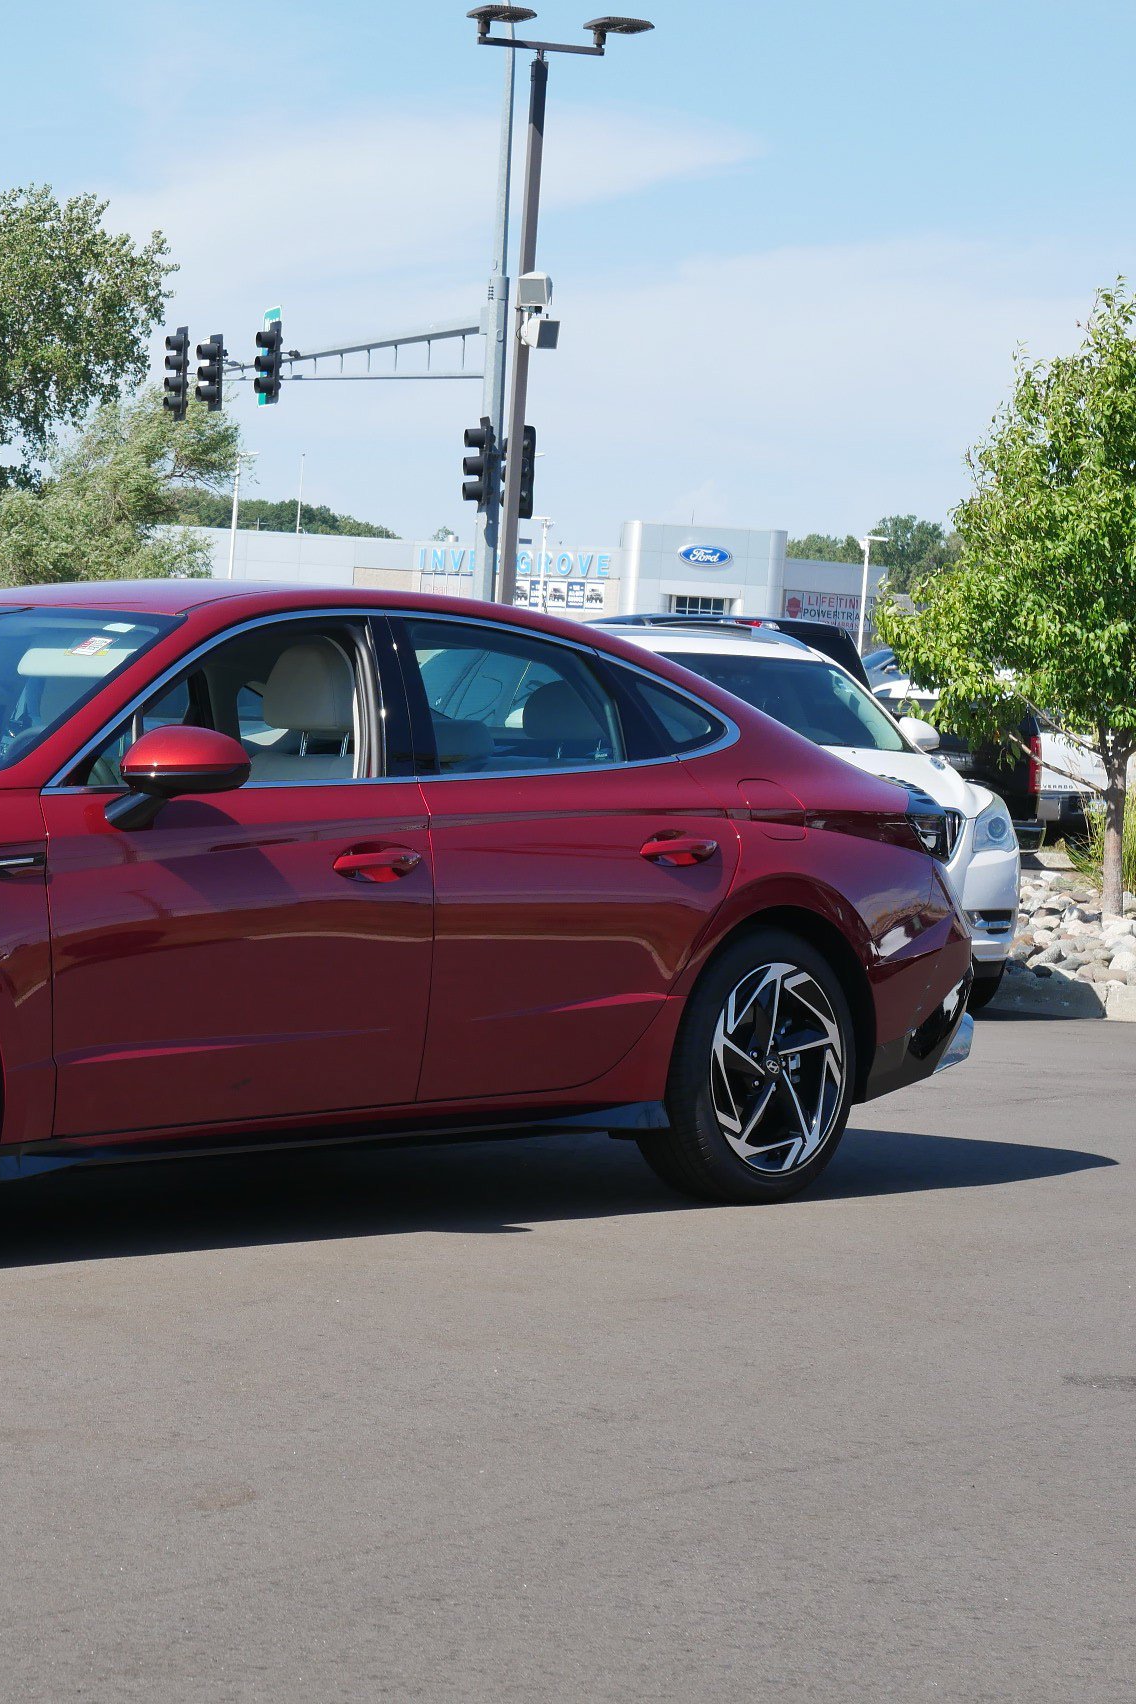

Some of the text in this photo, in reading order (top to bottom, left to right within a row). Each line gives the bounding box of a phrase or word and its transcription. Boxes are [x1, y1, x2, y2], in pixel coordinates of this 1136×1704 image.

[418, 548, 611, 577] INVE GROVE
[689, 548, 720, 563] Ford
[807, 595, 862, 609] LIFETIM
[802, 608, 870, 621] POWERTRAN
[830, 620, 867, 629] WARRANY
